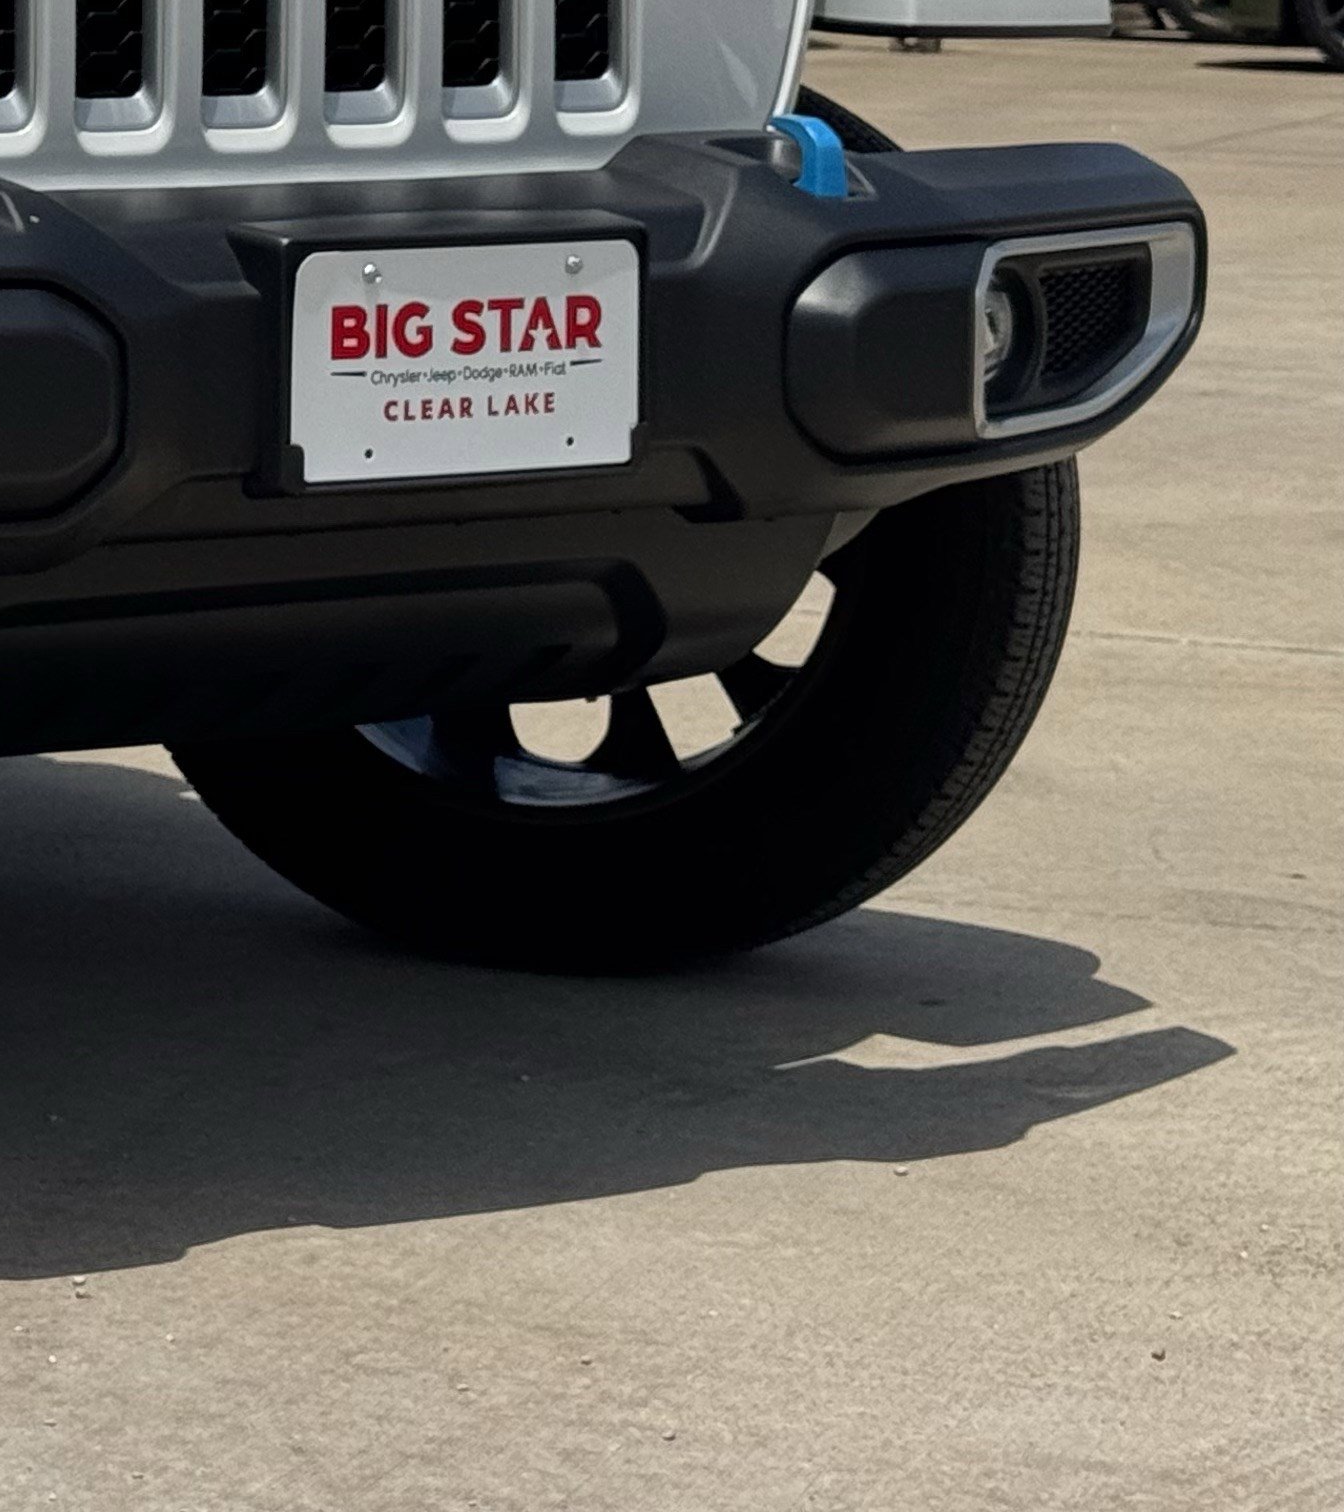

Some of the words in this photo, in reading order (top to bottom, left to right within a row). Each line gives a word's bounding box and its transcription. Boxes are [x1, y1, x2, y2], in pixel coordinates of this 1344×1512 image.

[330, 300, 434, 361] BIG
[450, 294, 603, 355] STAR
[383, 396, 474, 422] CLEAR
[487, 391, 556, 416] LAKE
